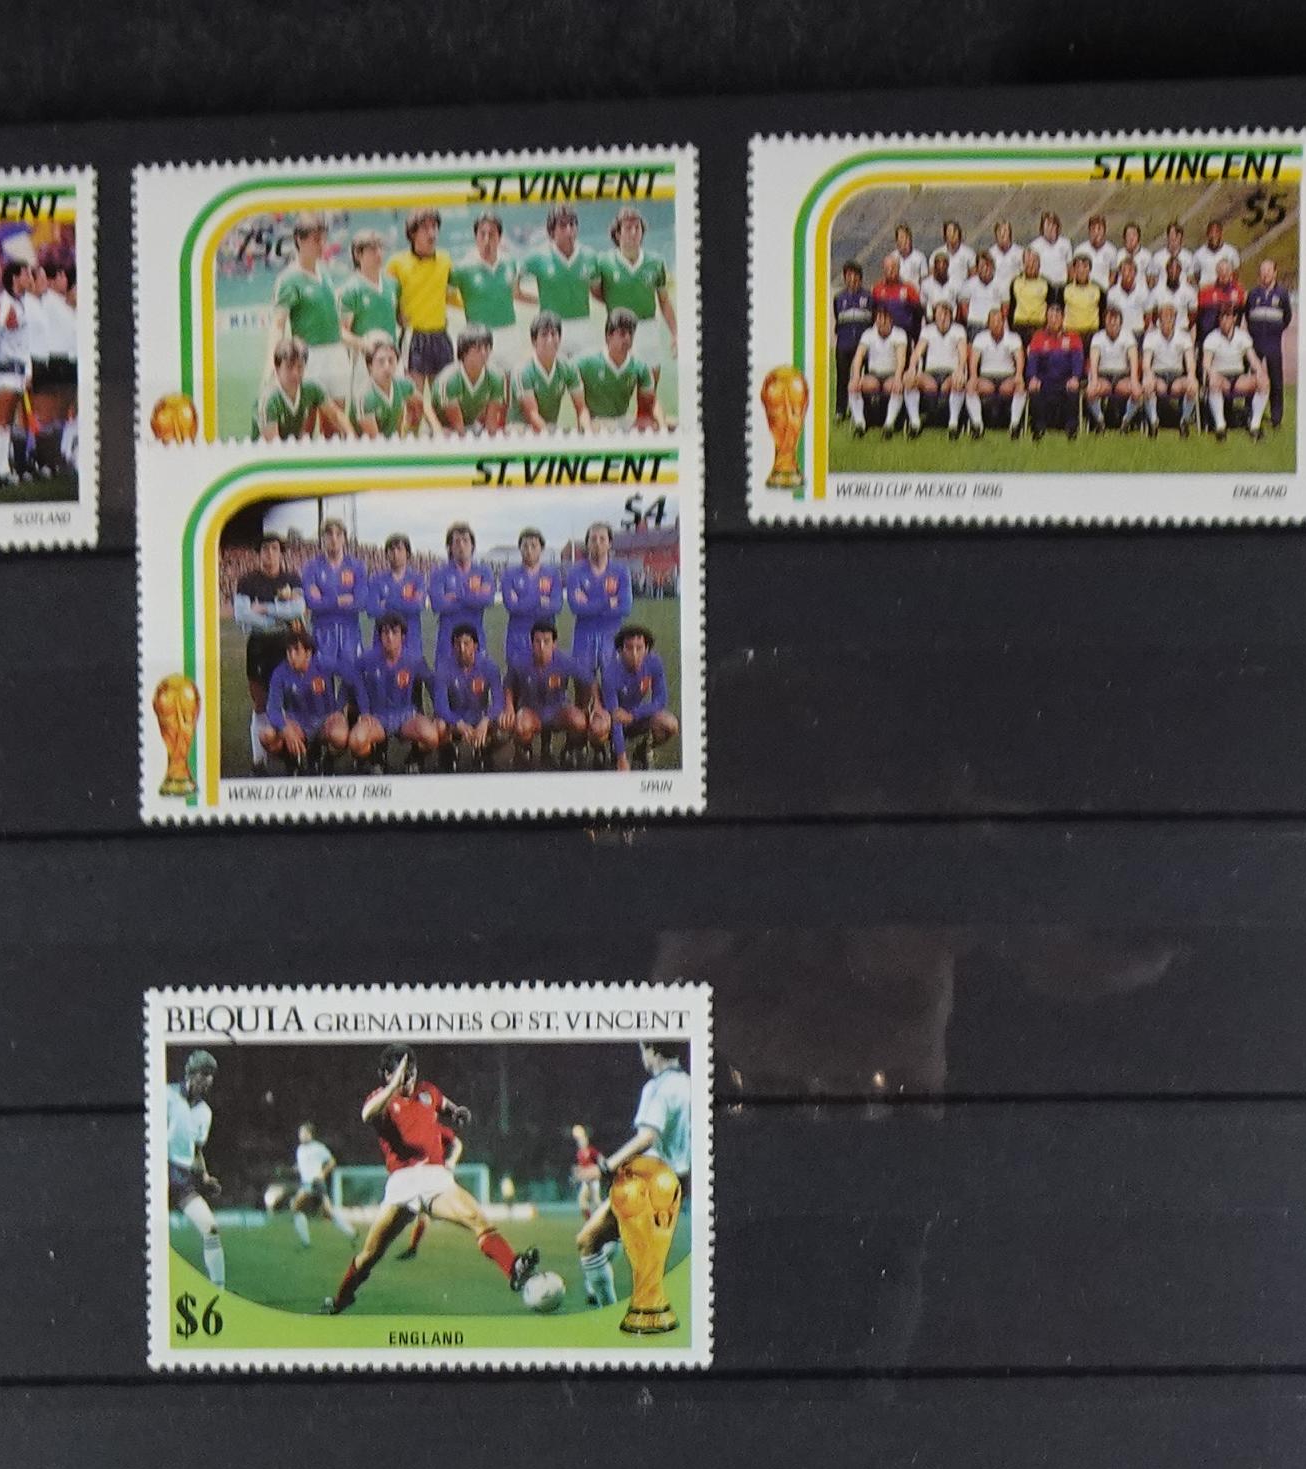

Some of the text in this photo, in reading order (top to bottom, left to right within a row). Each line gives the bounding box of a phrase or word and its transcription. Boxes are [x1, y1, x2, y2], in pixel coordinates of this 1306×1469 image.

[1143, 149, 1293, 180] VINCENT
[518, 167, 665, 201] VINCENT
[1243, 189, 1288, 227] $5
[523, 452, 671, 485] VINCENT
[836, 480, 1003, 498] WORLD CUP MEXICO 1986
[1231, 484, 1288, 498] ENGLAND
[620, 491, 668, 531] $4
[227, 782, 392, 801] WORLD CUP MEXICO 1986
[640, 779, 673, 793] SPAIN
[164, 1003, 307, 1046] BEQUIA
[314, 1010, 483, 1034] GRENADINES
[490, 1009, 524, 1032] OF
[565, 1009, 692, 1032] VINCENT
[175, 1291, 224, 1340] $6
[388, 1330, 465, 1346] ENGLAND
